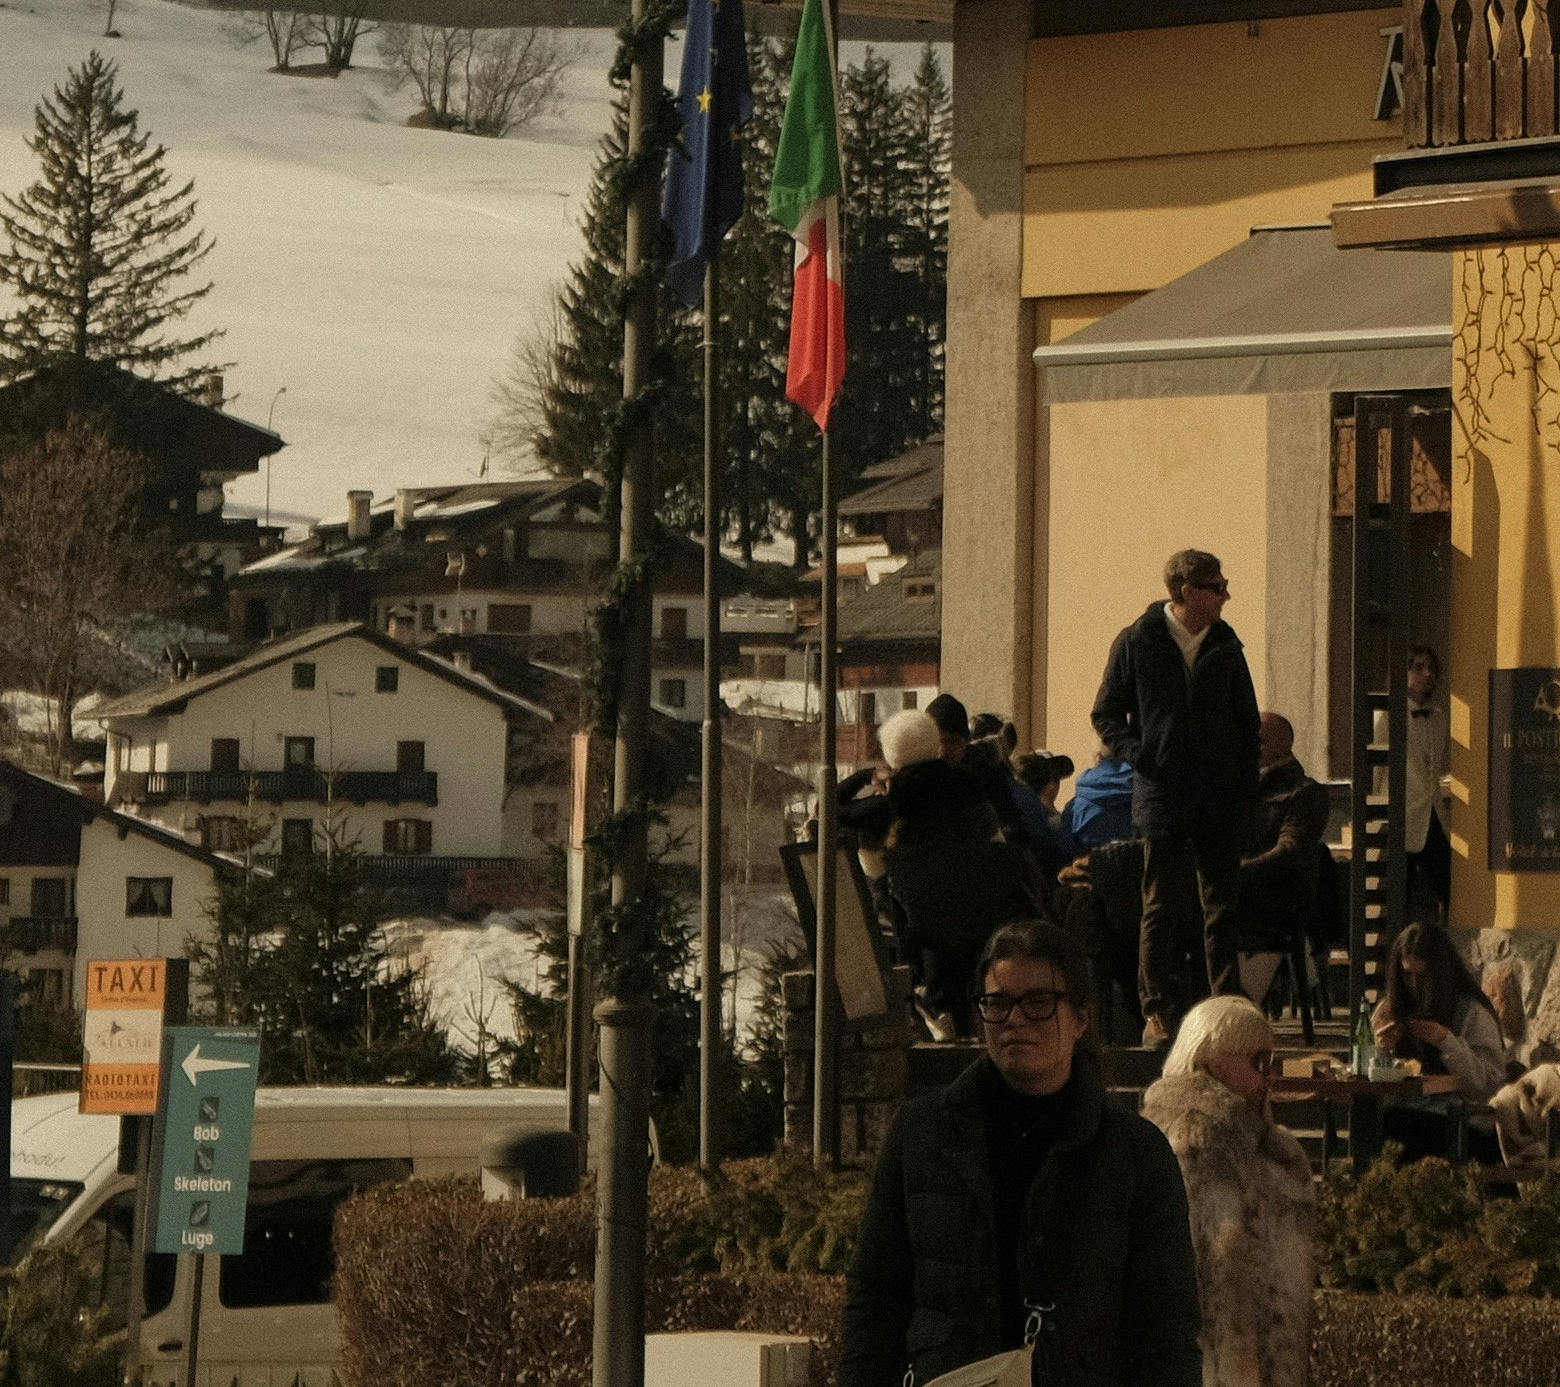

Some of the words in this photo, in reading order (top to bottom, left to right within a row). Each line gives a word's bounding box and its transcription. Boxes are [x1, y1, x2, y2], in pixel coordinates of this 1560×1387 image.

[94, 965, 159, 993] TAXI
[85, 1073, 156, 1086] RADIOTAXI
[193, 1126, 220, 1141] Bob
[173, 1175, 232, 1193] Skeleton
[181, 1230, 215, 1250] Luge
